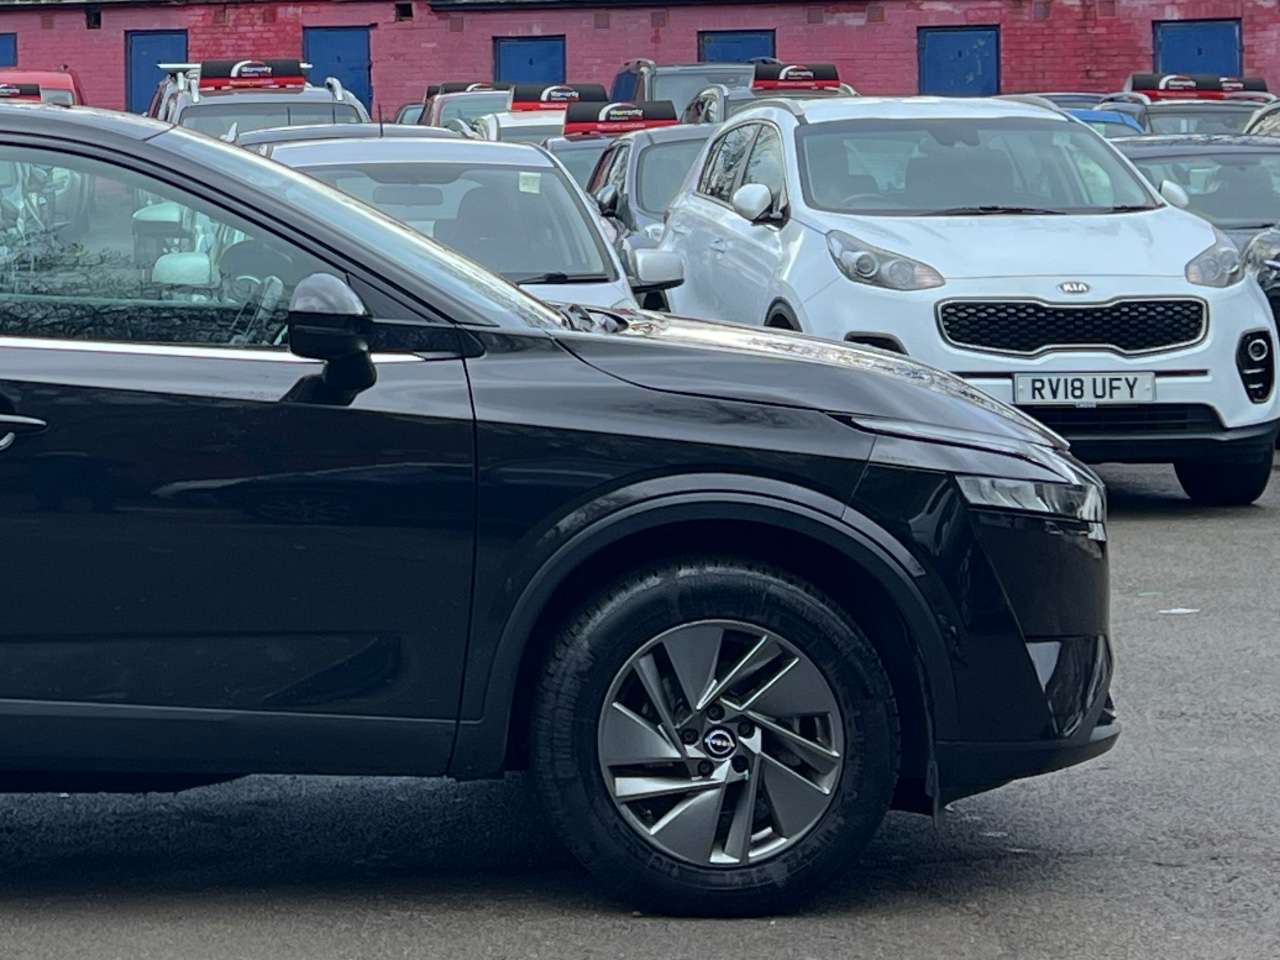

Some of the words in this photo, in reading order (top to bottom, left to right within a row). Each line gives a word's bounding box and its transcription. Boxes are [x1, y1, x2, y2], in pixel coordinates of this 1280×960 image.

[1061, 282, 1088, 292] KIA
[1031, 377, 1085, 400] RV18
[1092, 377, 1138, 400] UFY
